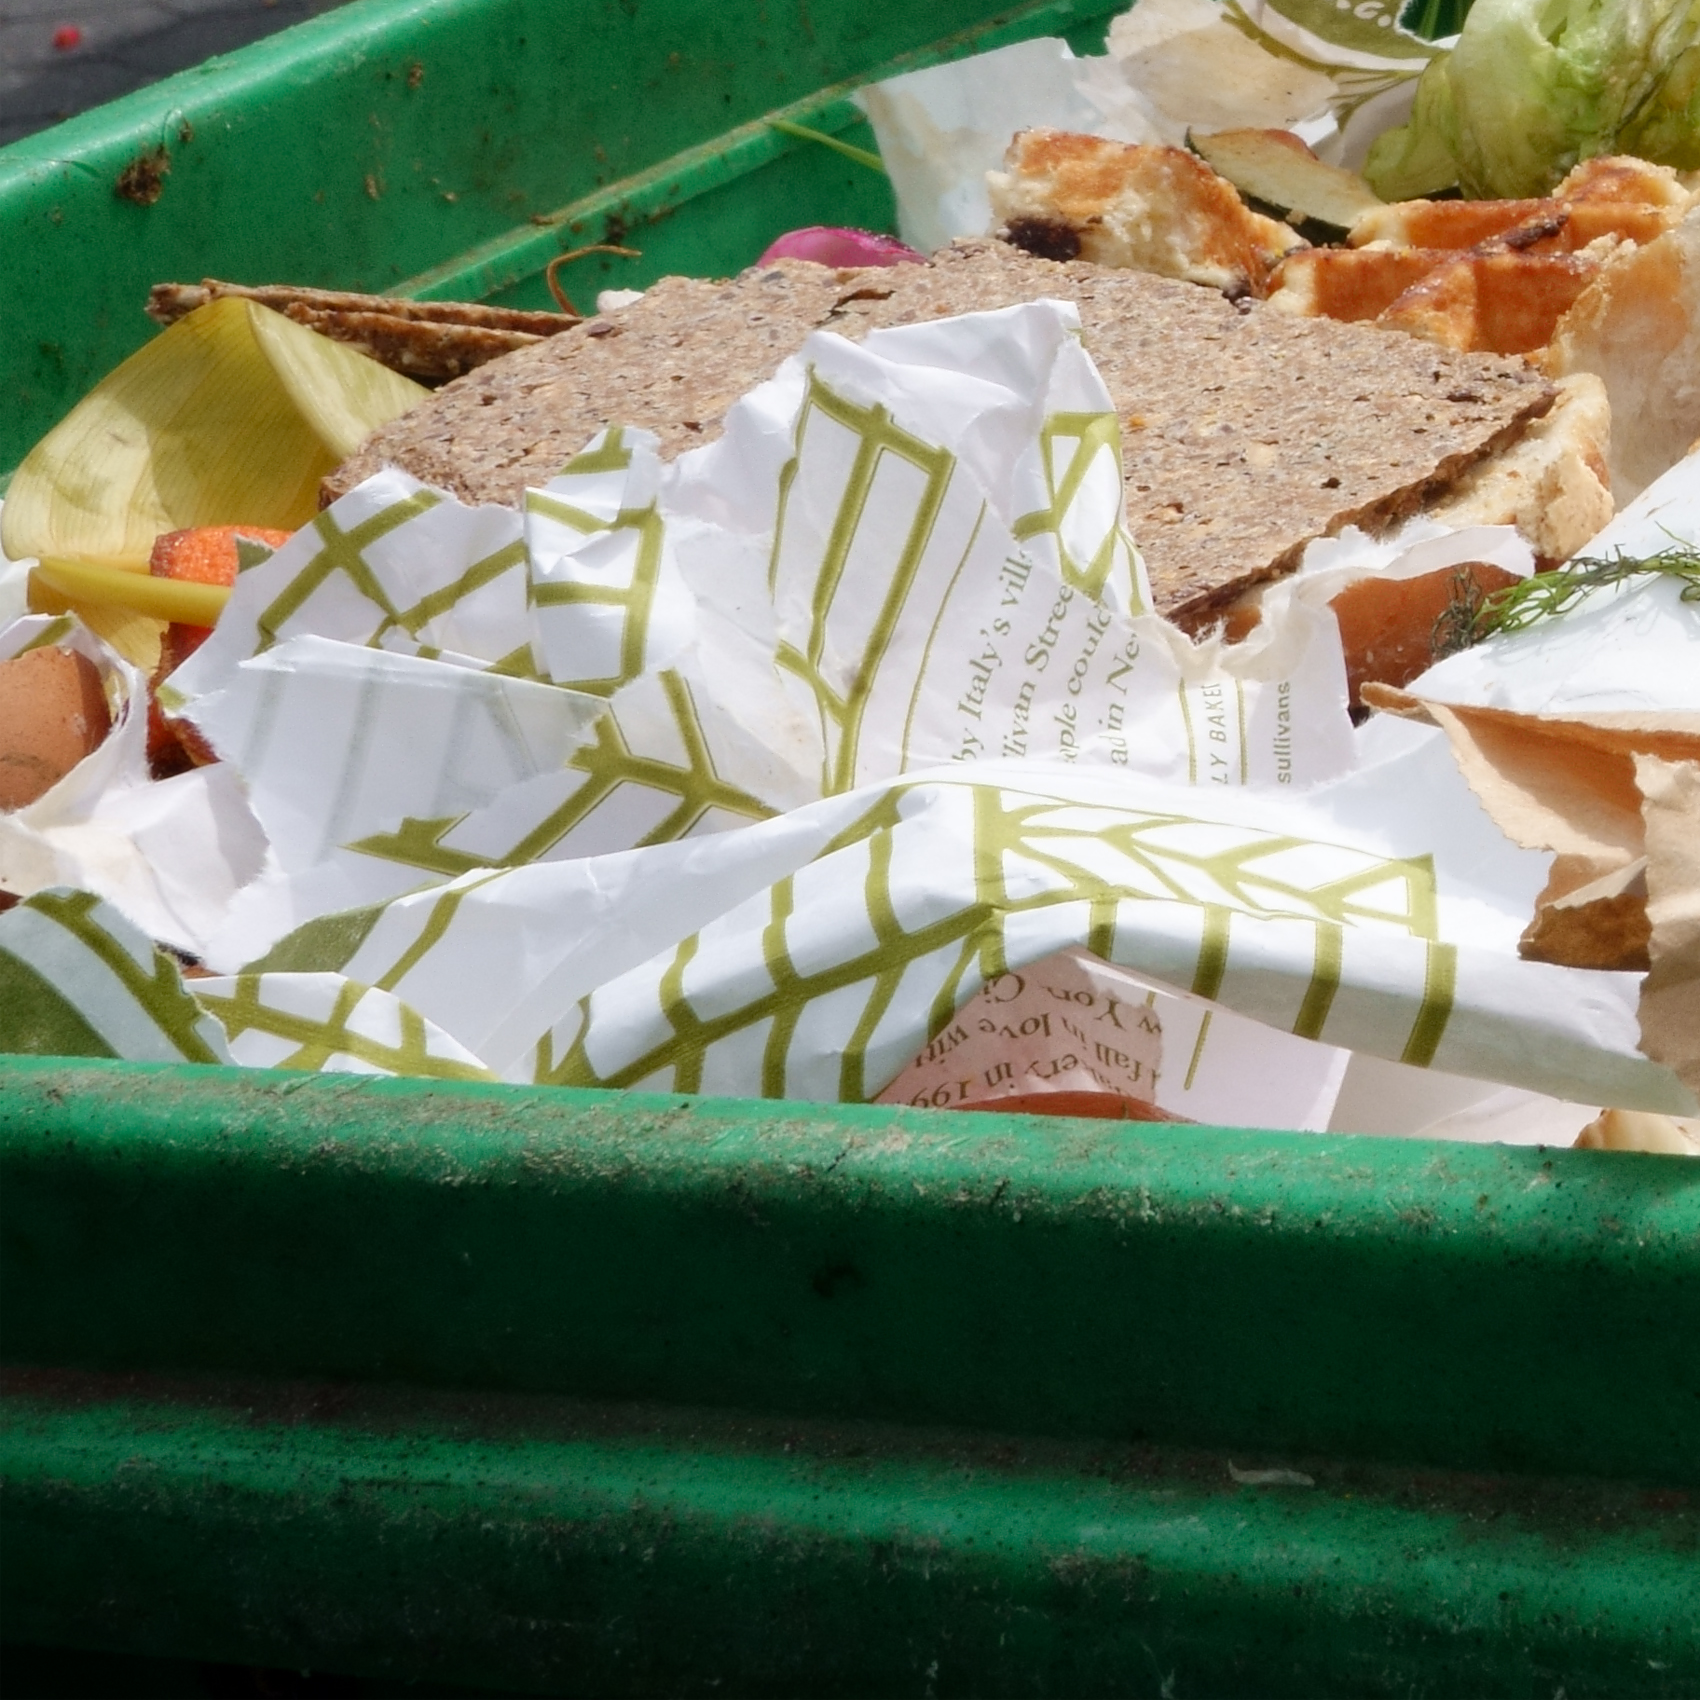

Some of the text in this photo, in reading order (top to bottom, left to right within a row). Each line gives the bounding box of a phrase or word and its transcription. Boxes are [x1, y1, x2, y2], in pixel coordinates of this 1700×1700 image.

[957, 617, 1011, 721] Italy's
[1104, 634, 1141, 696] Ne
[1098, 701, 1127, 733] in
[1273, 683, 1292, 785] sullivans
[978, 1011, 1052, 1041] love
[983, 1061, 1015, 1089] in
[1094, 1041, 1143, 1084] fall
